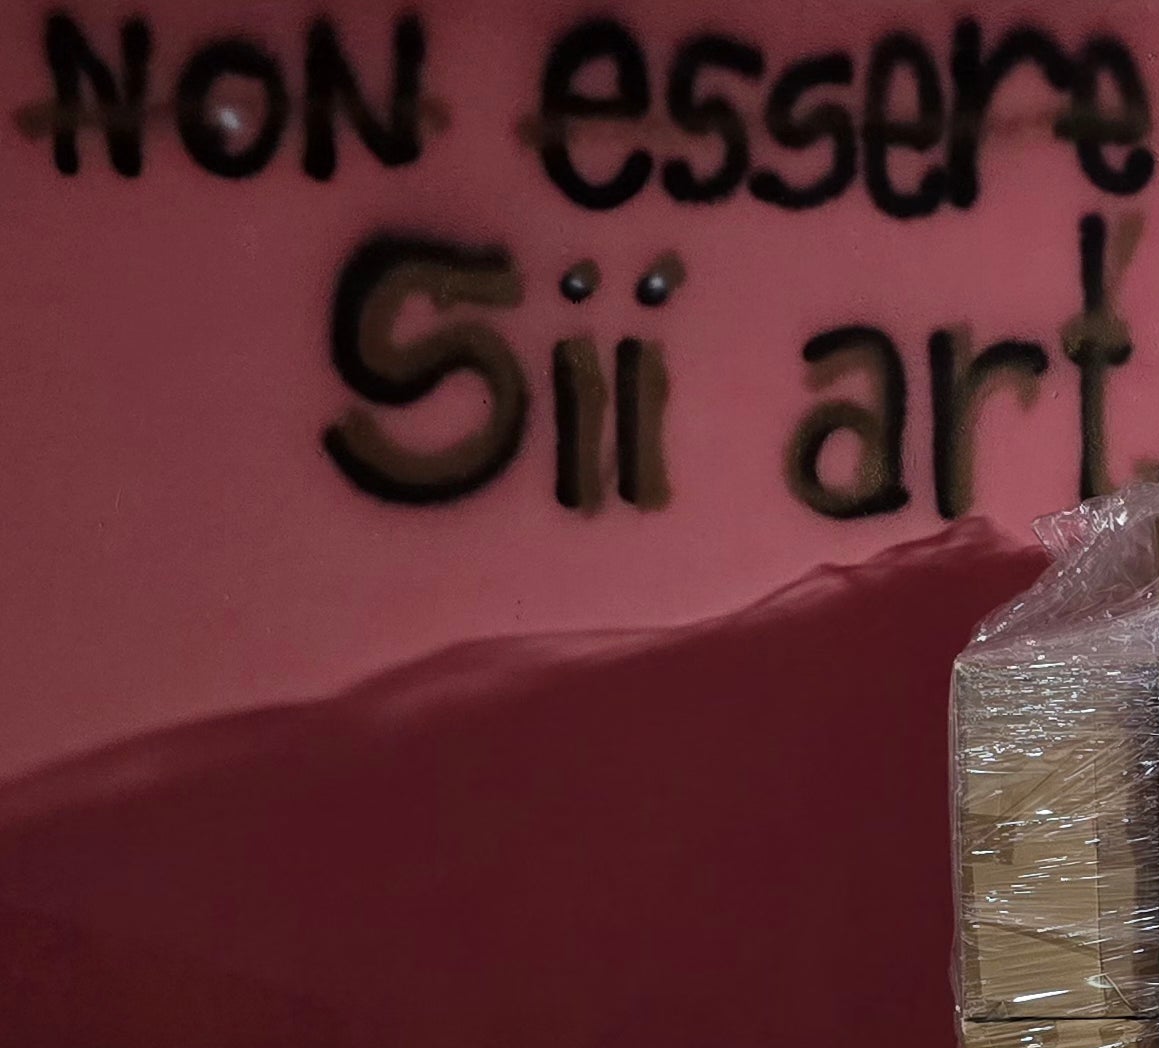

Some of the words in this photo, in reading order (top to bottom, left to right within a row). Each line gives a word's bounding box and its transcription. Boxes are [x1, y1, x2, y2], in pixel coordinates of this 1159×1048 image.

[45, 12, 430, 182] NON
[537, 16, 1155, 220] essere
[319, 229, 687, 518] Sii
